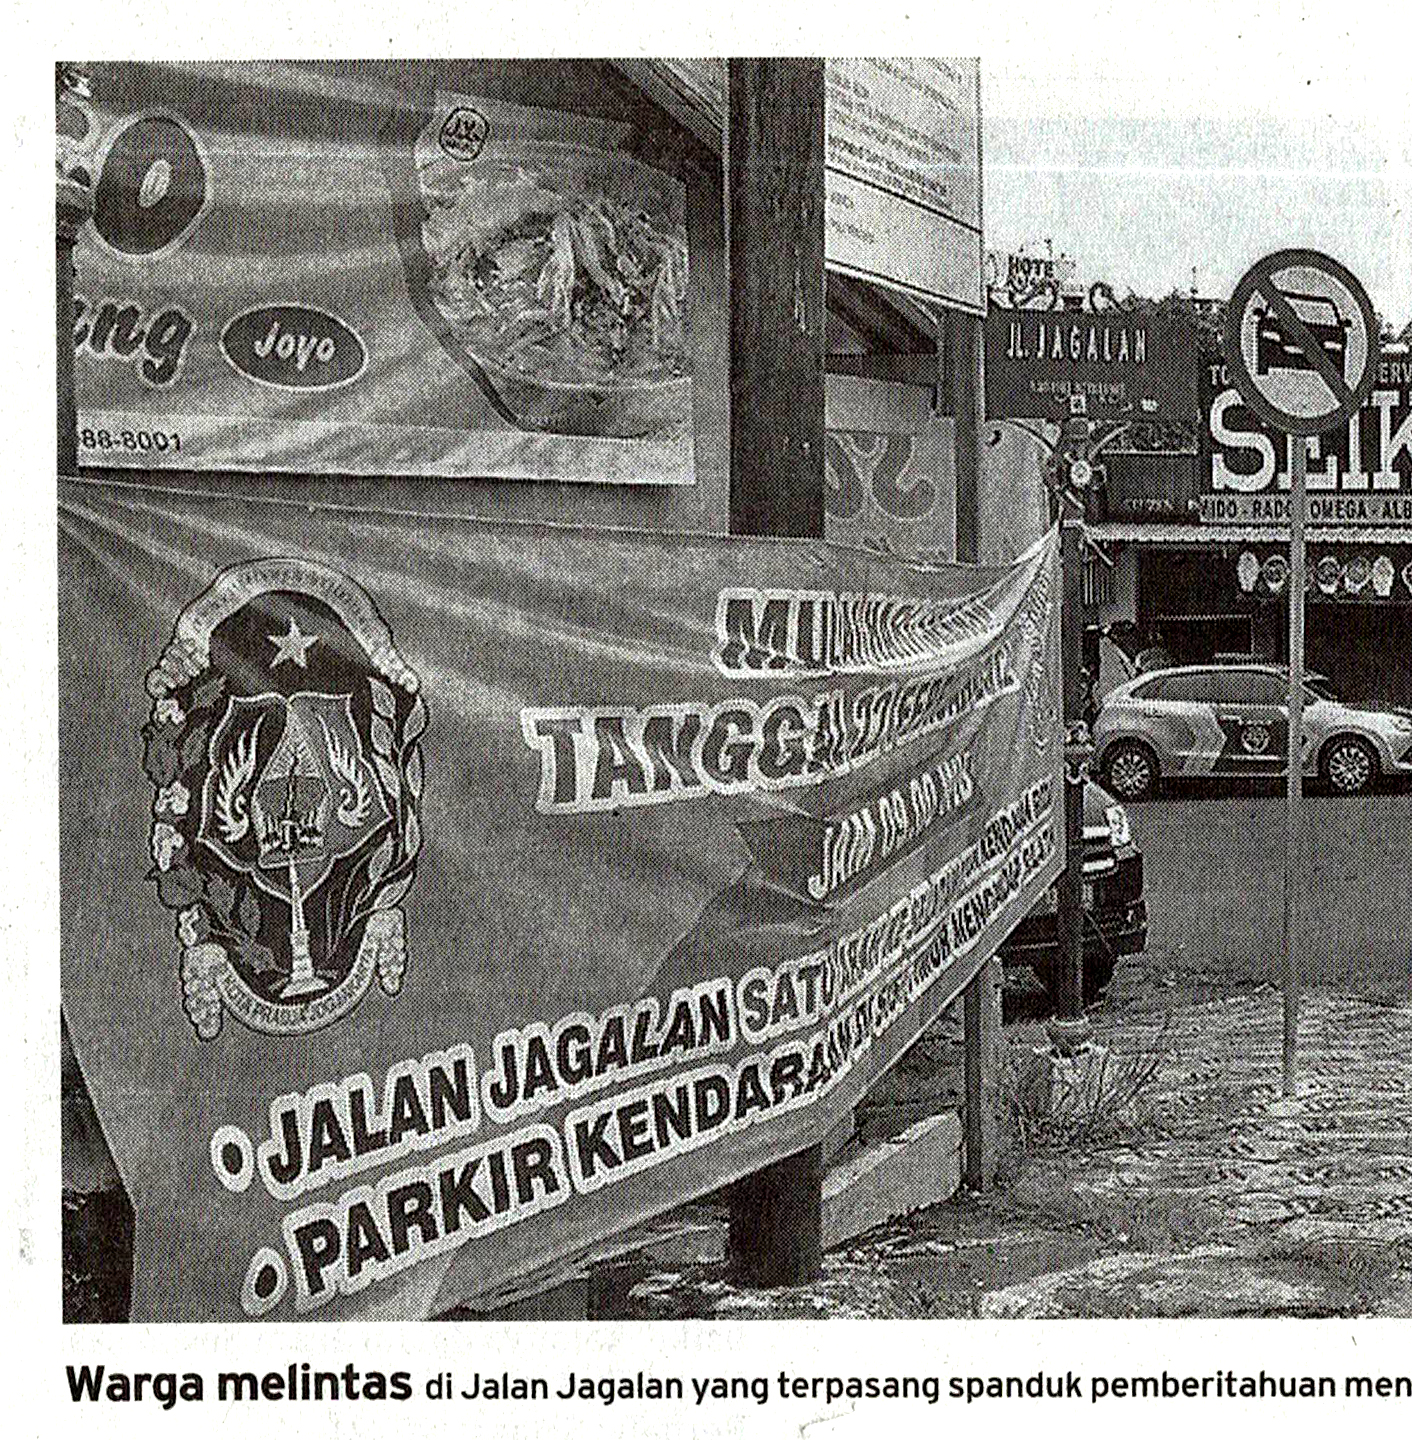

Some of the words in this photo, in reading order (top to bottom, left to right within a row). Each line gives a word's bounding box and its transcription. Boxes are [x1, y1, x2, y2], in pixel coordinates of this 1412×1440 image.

[254, 321, 337, 371] Joyo
[1007, 322, 1029, 358] JL.
[1037, 324, 1147, 362] JAGALAN
[1311, 499, 1368, 520] OMEGA
[528, 688, 850, 812] TANGGAL
[806, 808, 877, 900] JAM
[262, 1055, 475, 1190] JALAN
[488, 988, 732, 1115] JAGALAN
[290, 1132, 563, 1302] PARKIR
